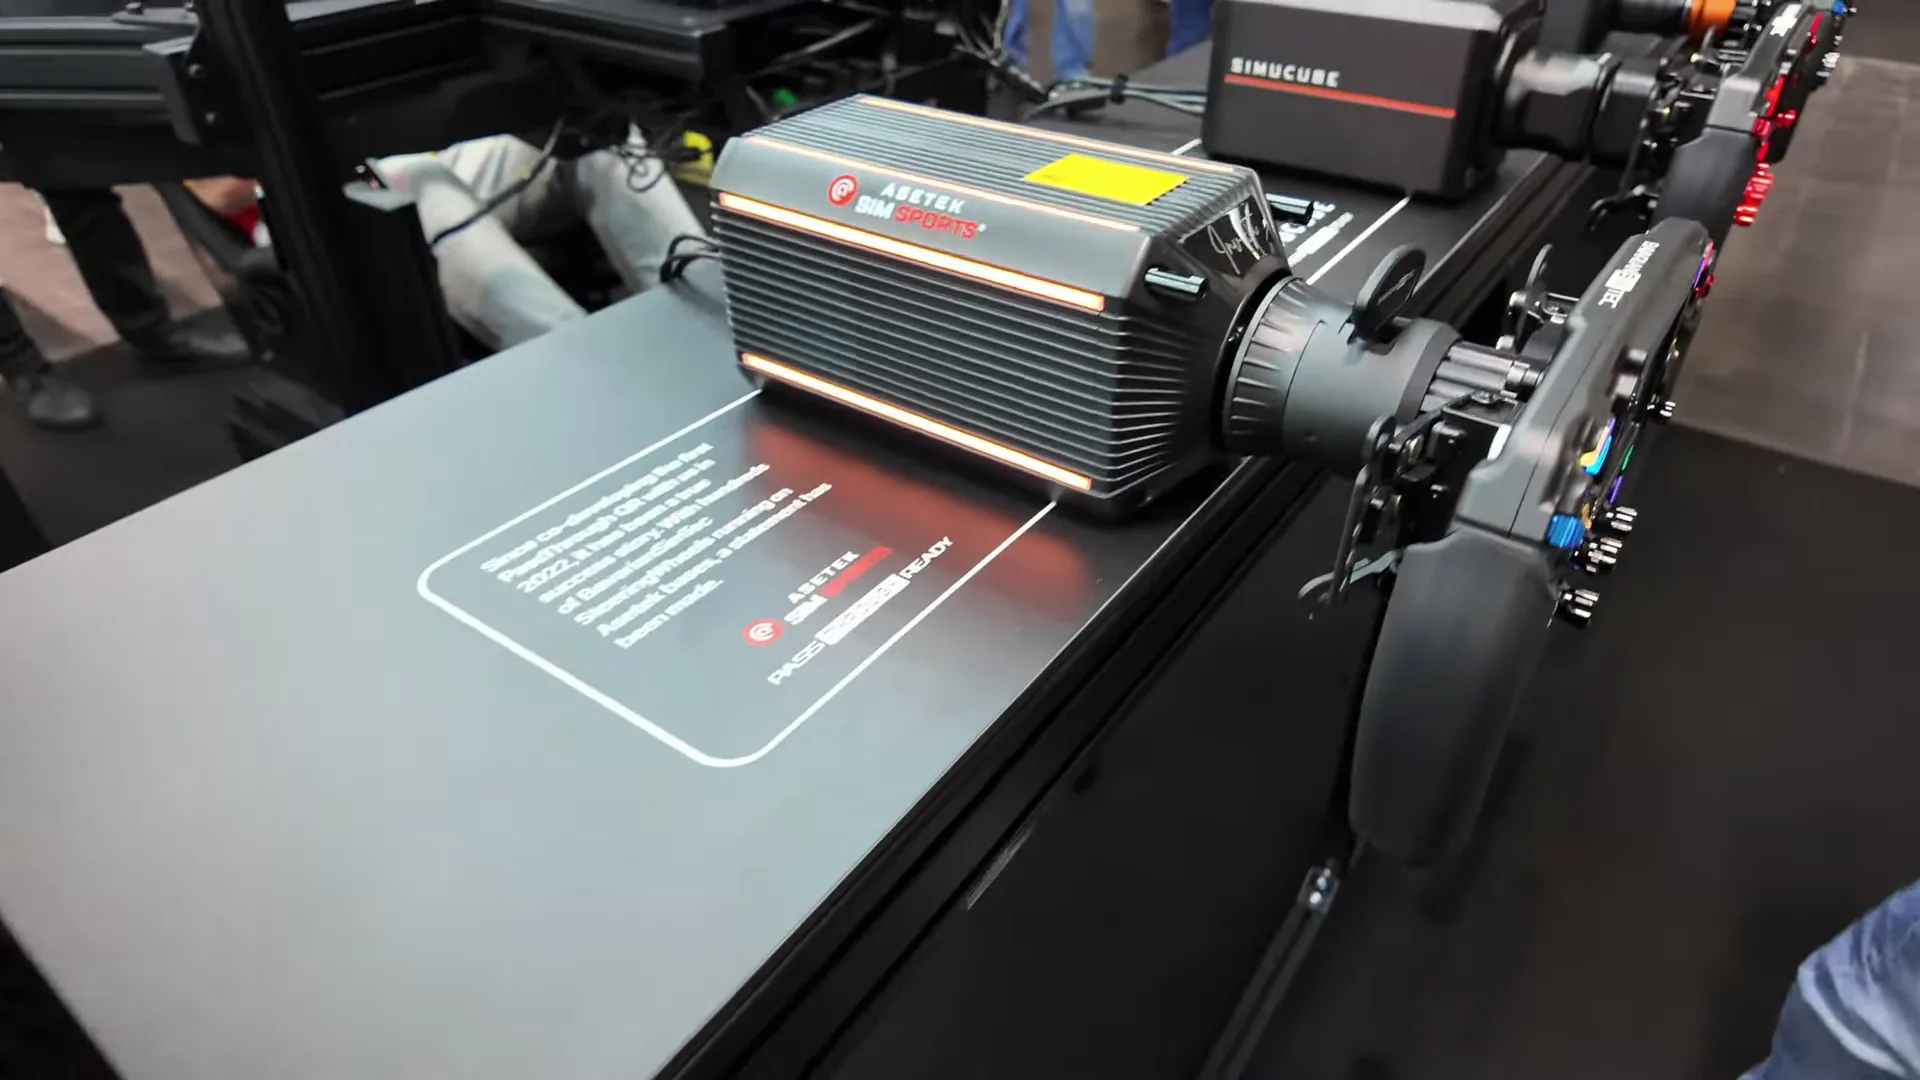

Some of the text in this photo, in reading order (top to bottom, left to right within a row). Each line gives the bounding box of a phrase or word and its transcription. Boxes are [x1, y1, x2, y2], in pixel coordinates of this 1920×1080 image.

[1230, 56, 1340, 88] SIMUCUBE
[855, 195, 896, 220] SIM
[880, 182, 966, 214] ASETEK
[788, 551, 860, 604] ASETEK
[767, 640, 826, 685] PASS
[899, 536, 953, 579] READY
